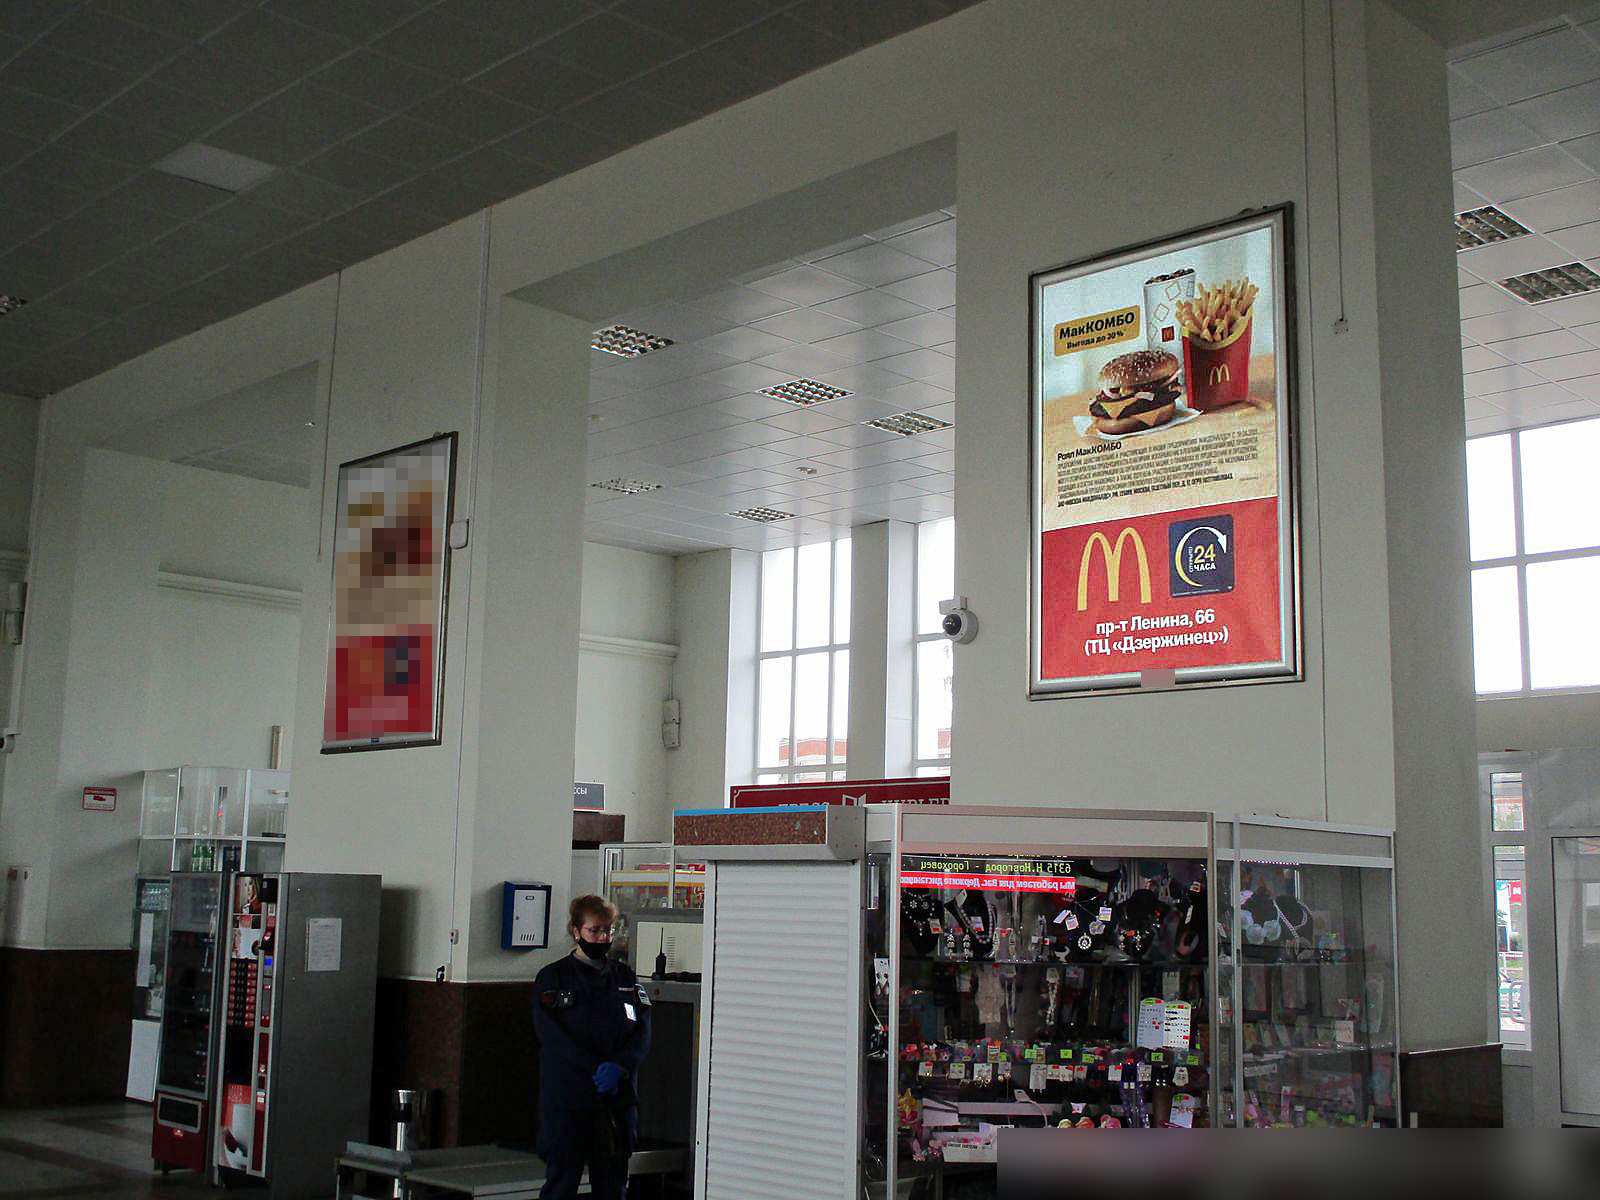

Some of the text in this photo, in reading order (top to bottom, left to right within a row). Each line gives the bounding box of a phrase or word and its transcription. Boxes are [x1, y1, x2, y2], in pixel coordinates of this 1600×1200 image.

[1059, 312, 1135, 340] МакКОМБО
[1075, 440, 1122, 458] МакКОМБО
[1194, 543, 1216, 564] 24
[1193, 562, 1216, 572] ЧАСА
[1096, 608, 1215, 636] пр-т Ленина, 66
[1084, 625, 1229, 657] (ТЦ «Дзержинец»)
